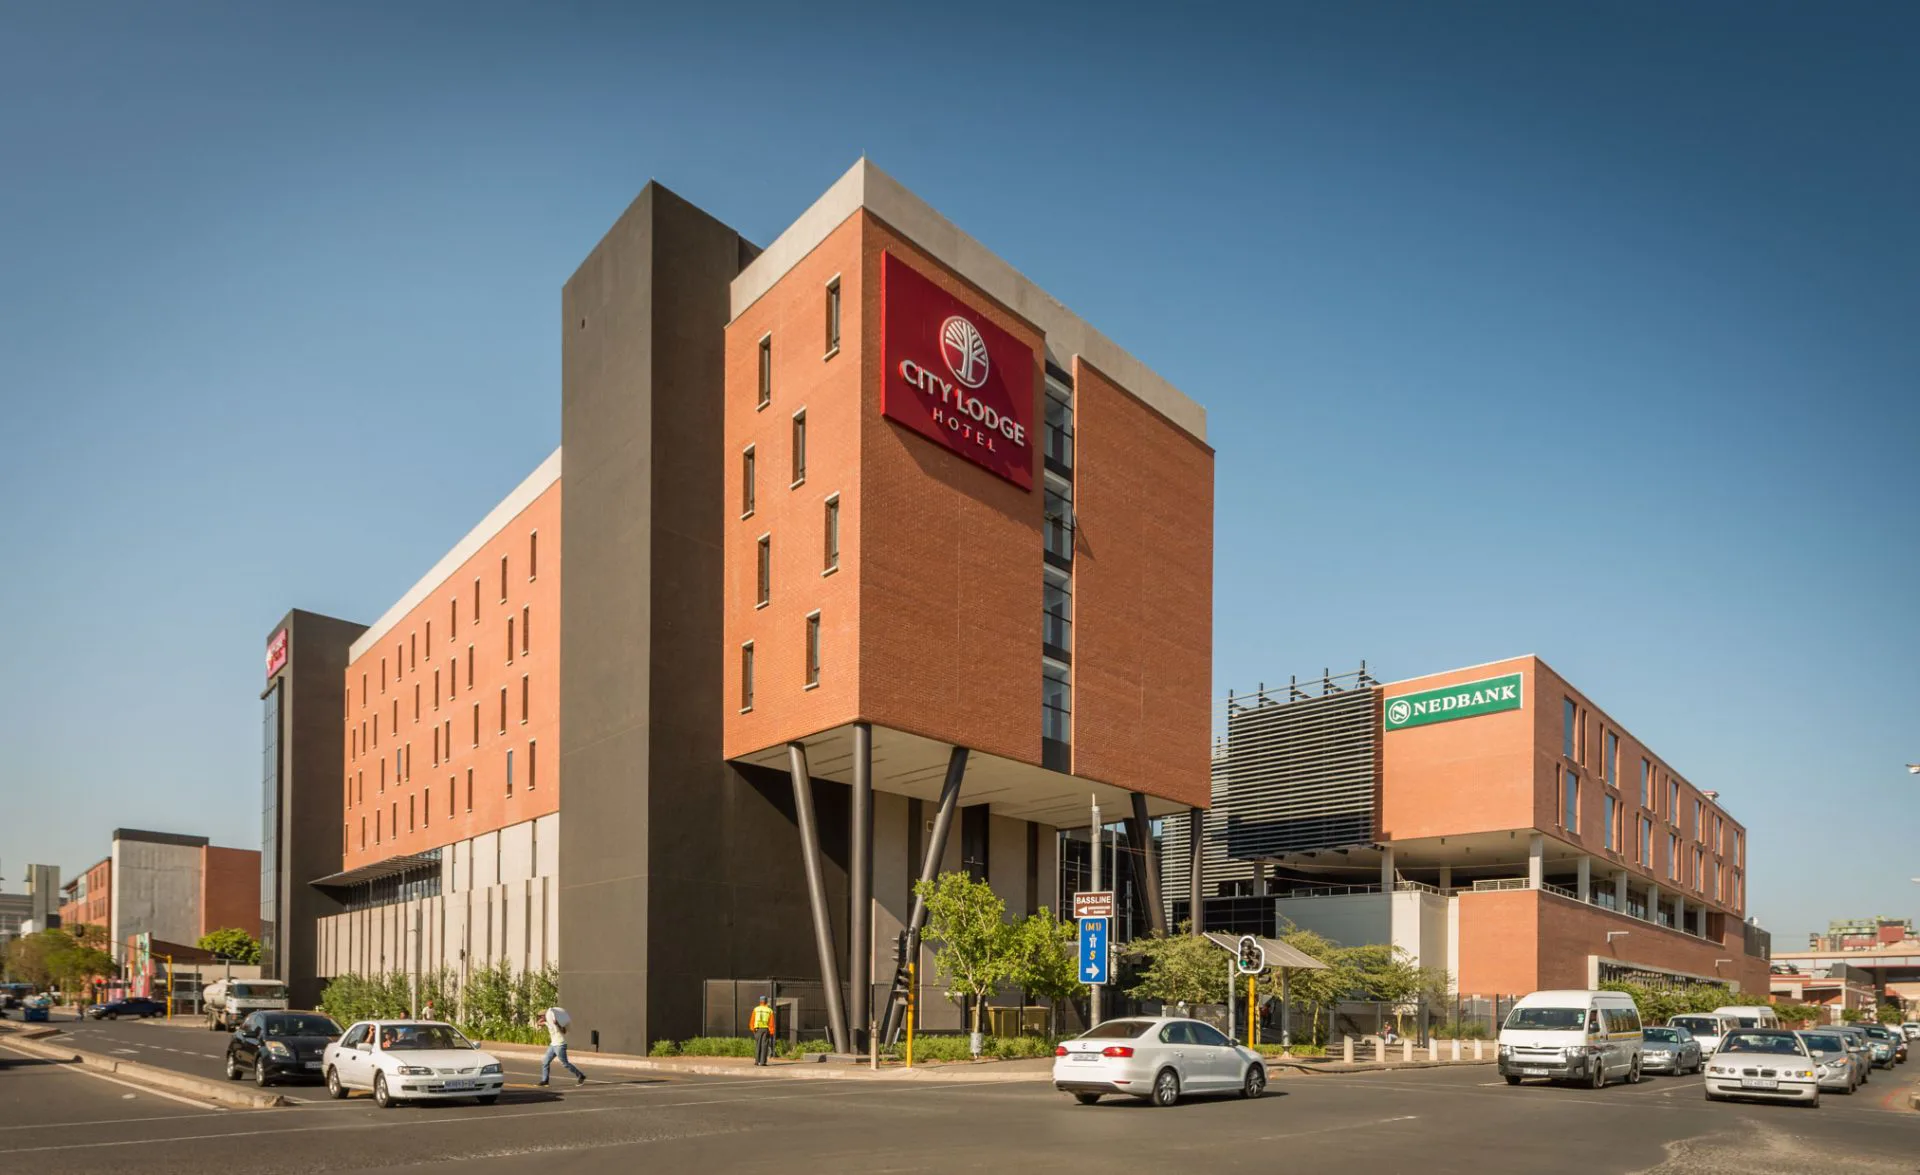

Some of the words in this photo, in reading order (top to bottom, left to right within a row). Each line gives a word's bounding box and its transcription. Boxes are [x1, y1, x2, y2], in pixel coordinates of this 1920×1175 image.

[900, 359, 952, 404] CITY
[956, 389, 1025, 447] LODGE
[932, 407, 997, 452] HOTEL
[1413, 684, 1516, 716] NEDBANK
[1076, 896, 1111, 904] BASSLINE
[1085, 922, 1101, 931] (M1)
[1089, 950, 1096, 960] S
